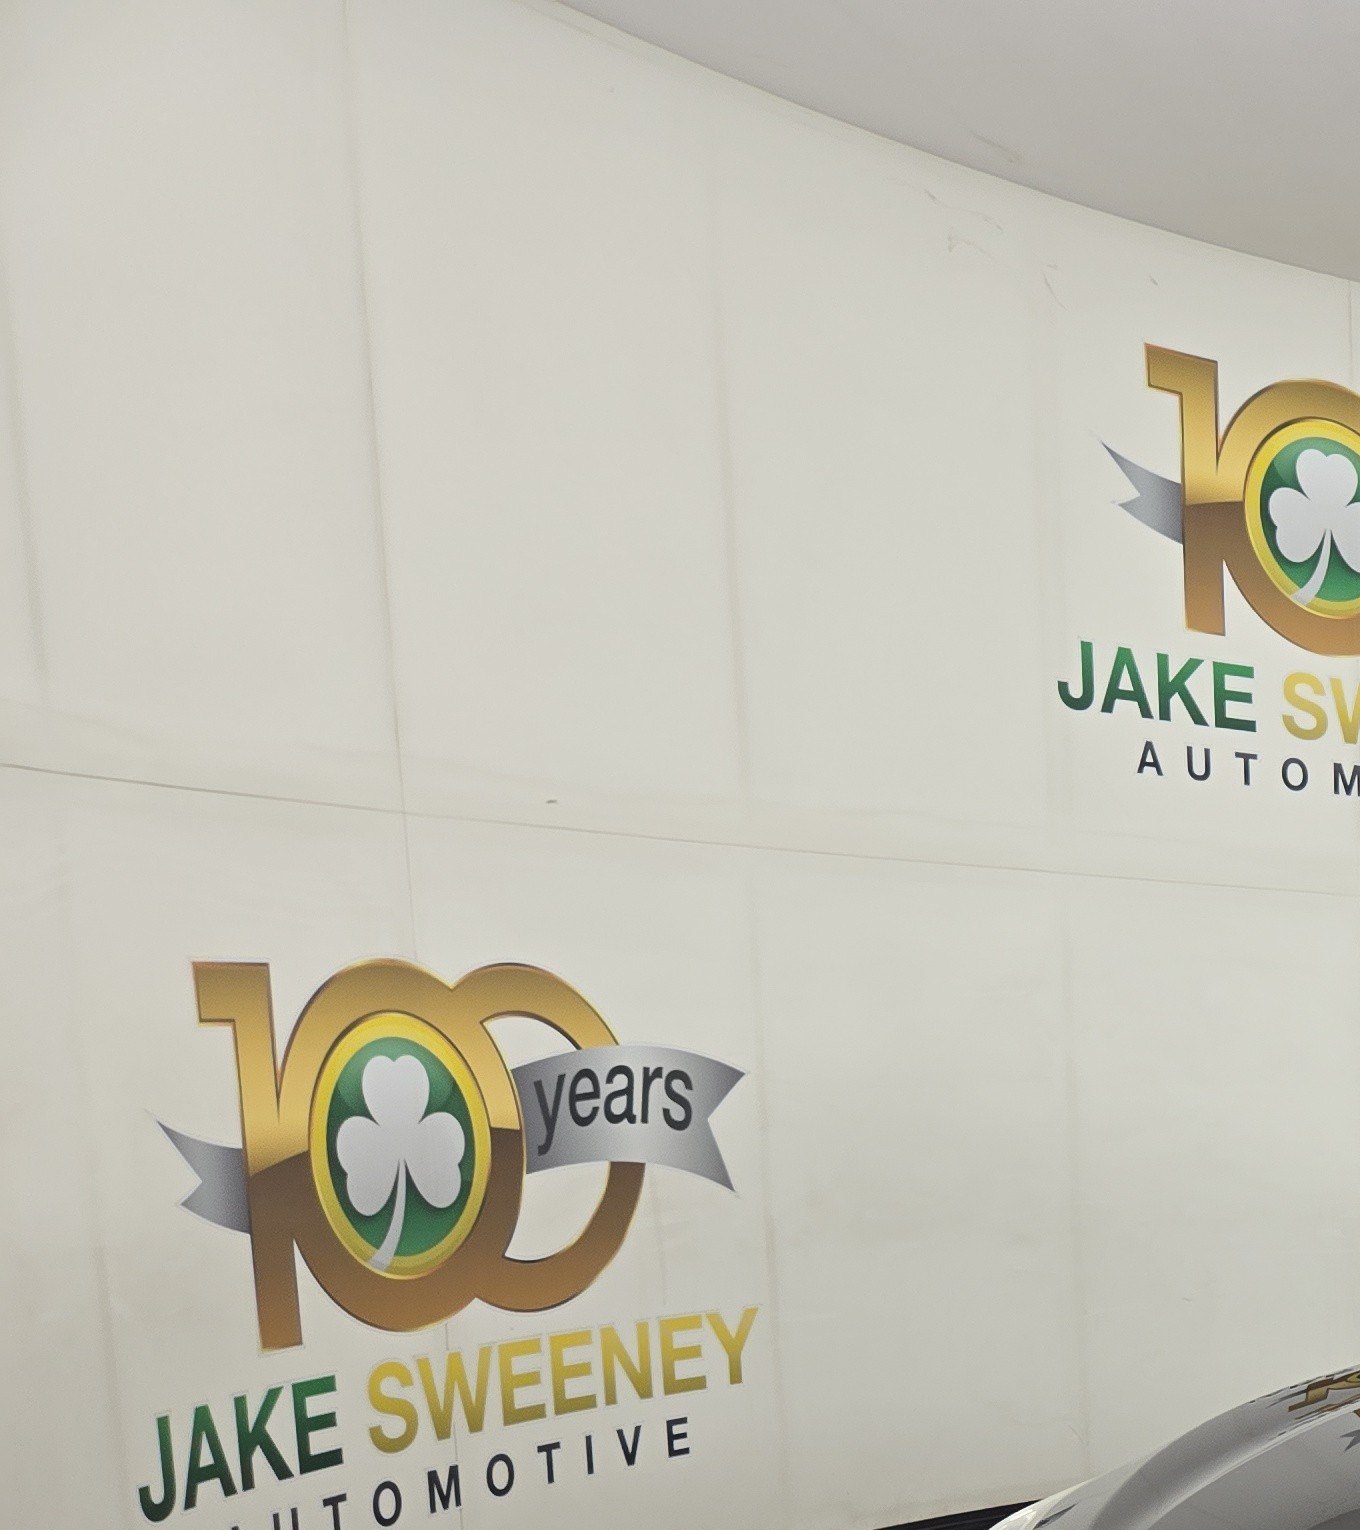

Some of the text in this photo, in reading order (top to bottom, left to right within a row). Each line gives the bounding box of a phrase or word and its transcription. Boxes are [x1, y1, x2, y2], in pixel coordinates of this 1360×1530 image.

[1057, 640, 1258, 734] JAKE
[533, 1064, 694, 1157] years
[137, 1307, 759, 1523] JAKE SWEENEY
